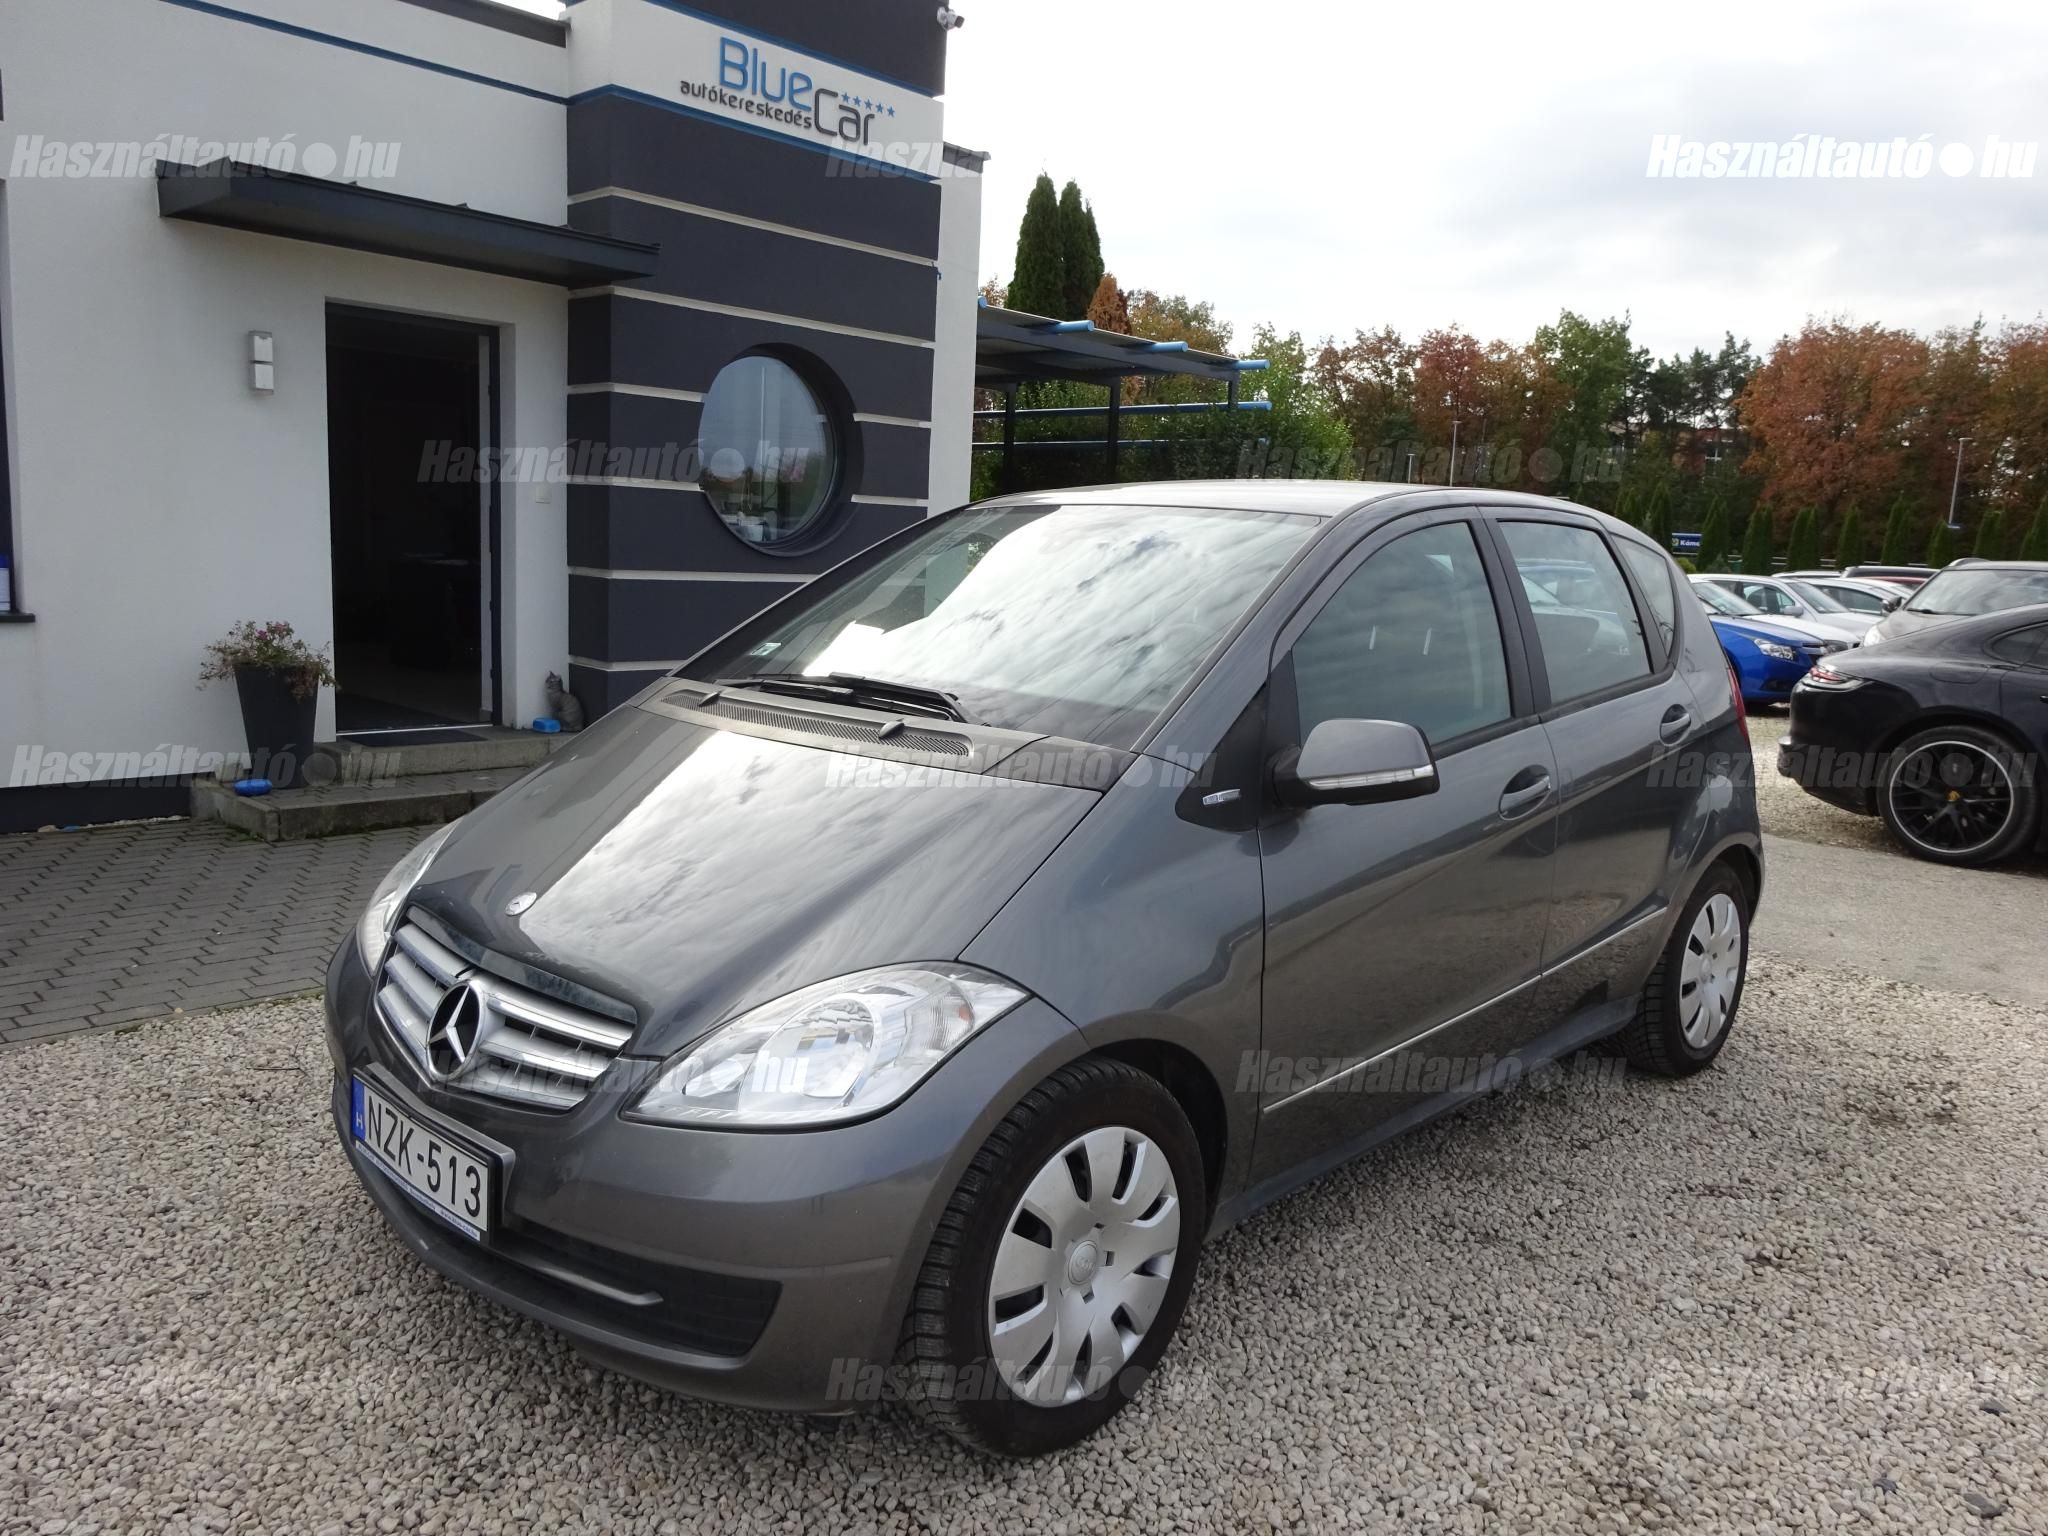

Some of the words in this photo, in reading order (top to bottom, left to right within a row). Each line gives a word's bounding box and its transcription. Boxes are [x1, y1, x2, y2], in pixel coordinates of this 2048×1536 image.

[680, 78, 813, 130] autókereskedés
[355, 1111, 364, 1130] H
[368, 1095, 481, 1218] NZK-513
